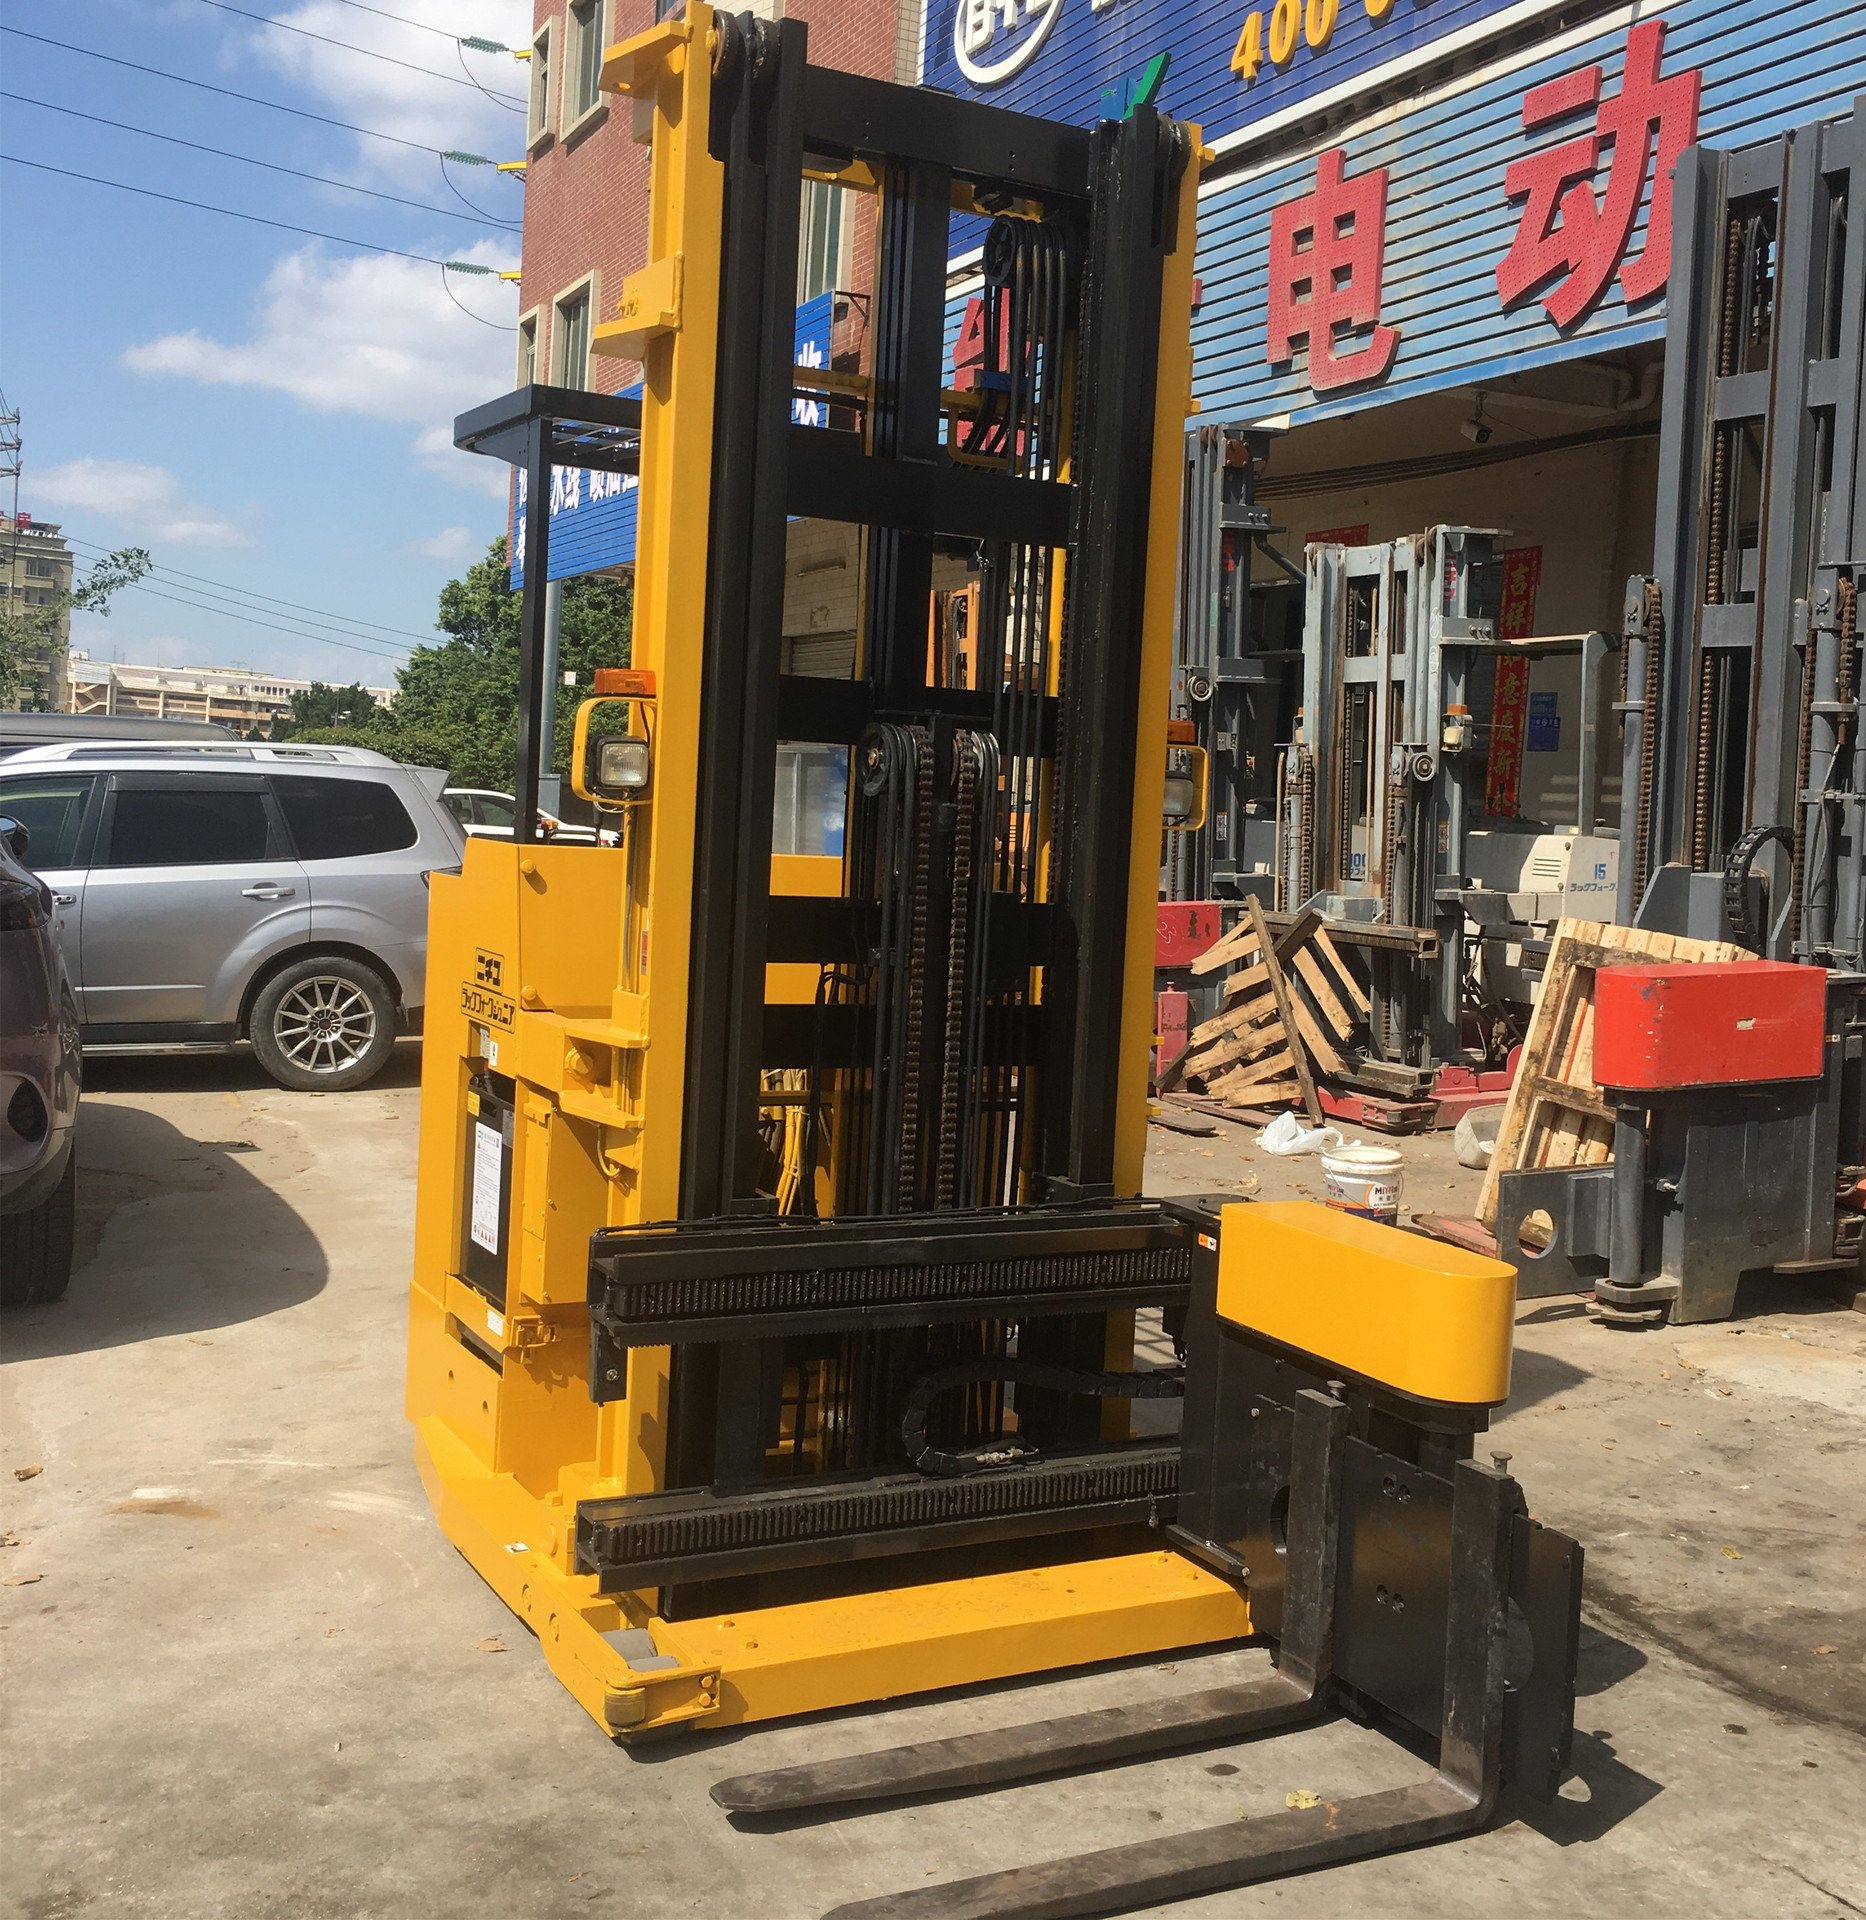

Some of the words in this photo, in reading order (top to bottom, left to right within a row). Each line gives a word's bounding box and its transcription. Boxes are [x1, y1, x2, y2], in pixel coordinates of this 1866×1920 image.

[1266, 20, 1702, 392] 电动
[1594, 863, 1607, 880] 15
[1570, 882, 1618, 892] ラックフォーク
